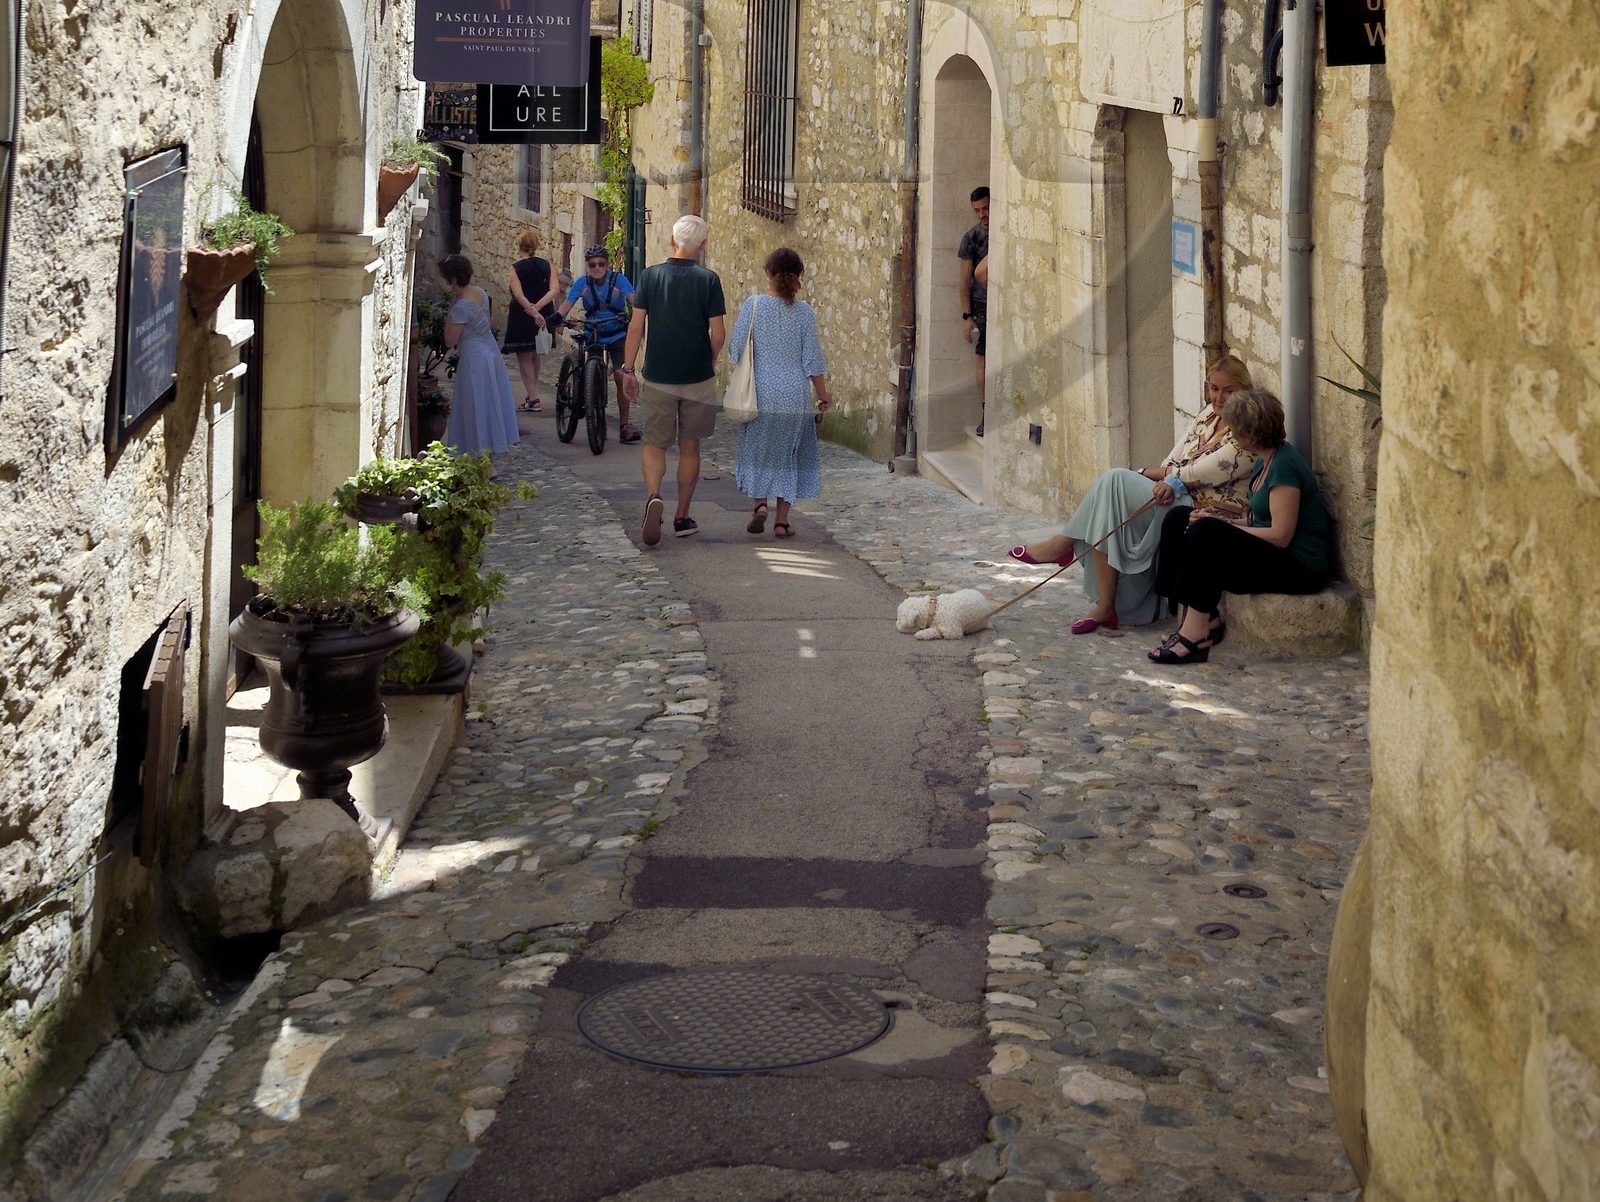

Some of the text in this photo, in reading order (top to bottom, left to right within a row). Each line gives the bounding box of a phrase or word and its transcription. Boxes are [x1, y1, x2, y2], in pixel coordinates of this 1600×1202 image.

[435, 12, 571, 26] PASCUAL LEANDRI
[460, 26, 546, 38] PROPERTIES
[486, 45, 505, 53] PAUL
[517, 84, 561, 97] ALL
[516, 106, 562, 123] URE
